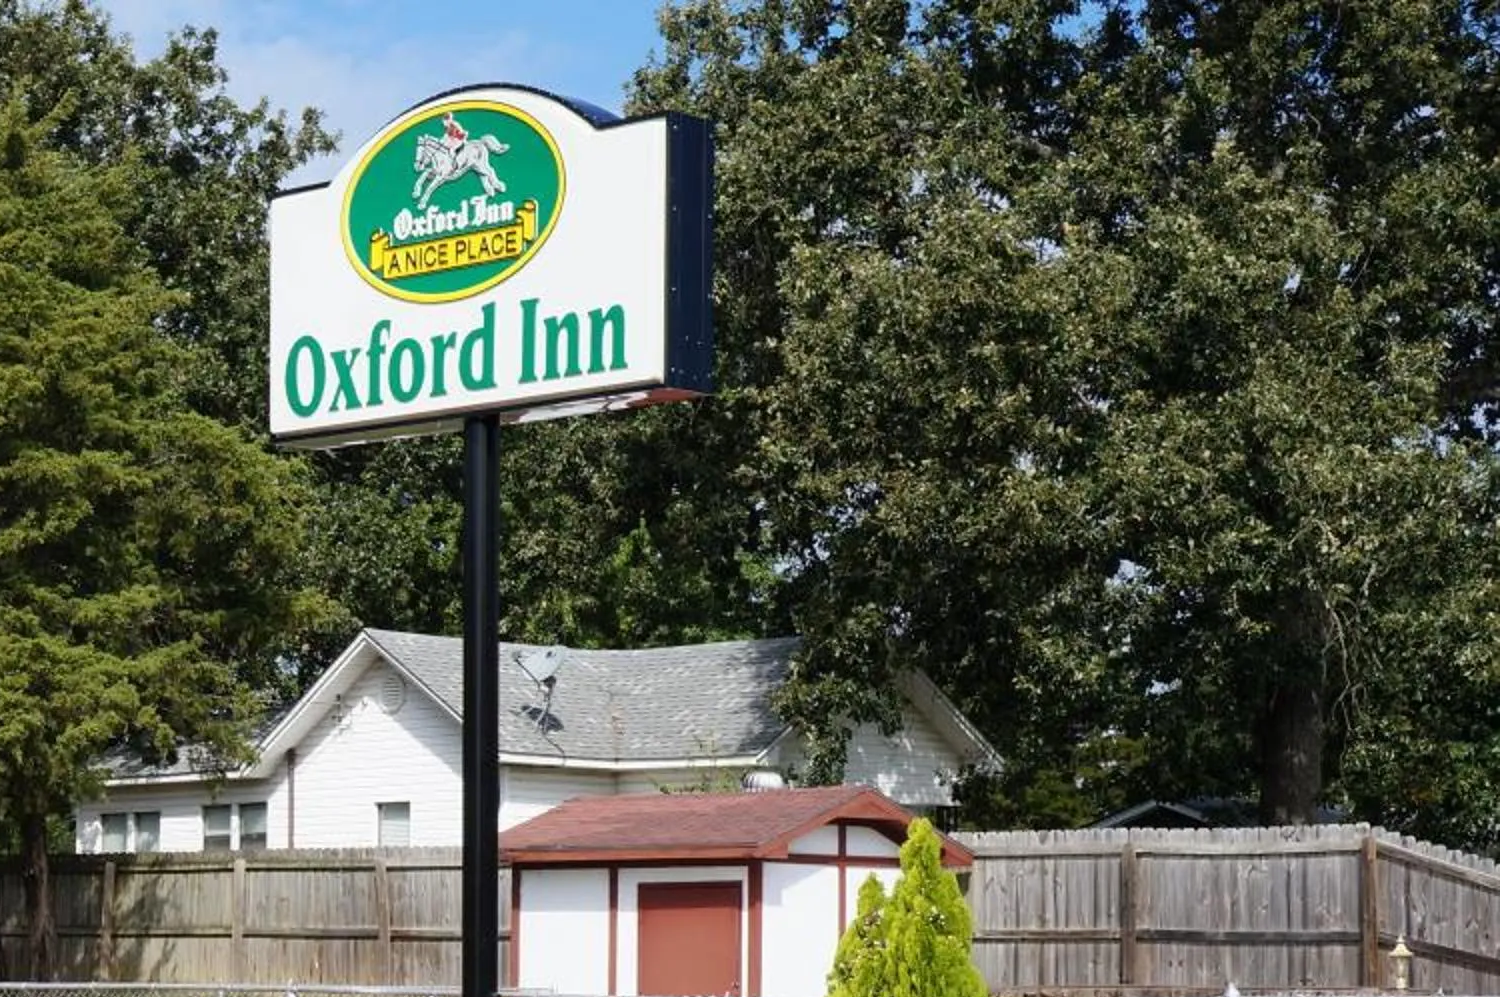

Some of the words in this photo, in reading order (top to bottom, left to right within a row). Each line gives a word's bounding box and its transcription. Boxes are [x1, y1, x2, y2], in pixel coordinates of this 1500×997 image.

[394, 199, 469, 240] Oxford
[470, 195, 514, 227] Inn
[388, 253, 401, 273] A
[405, 243, 449, 270] NICE
[454, 230, 518, 264] PLACE
[284, 300, 497, 418] Oxford
[517, 298, 629, 384] Inn
